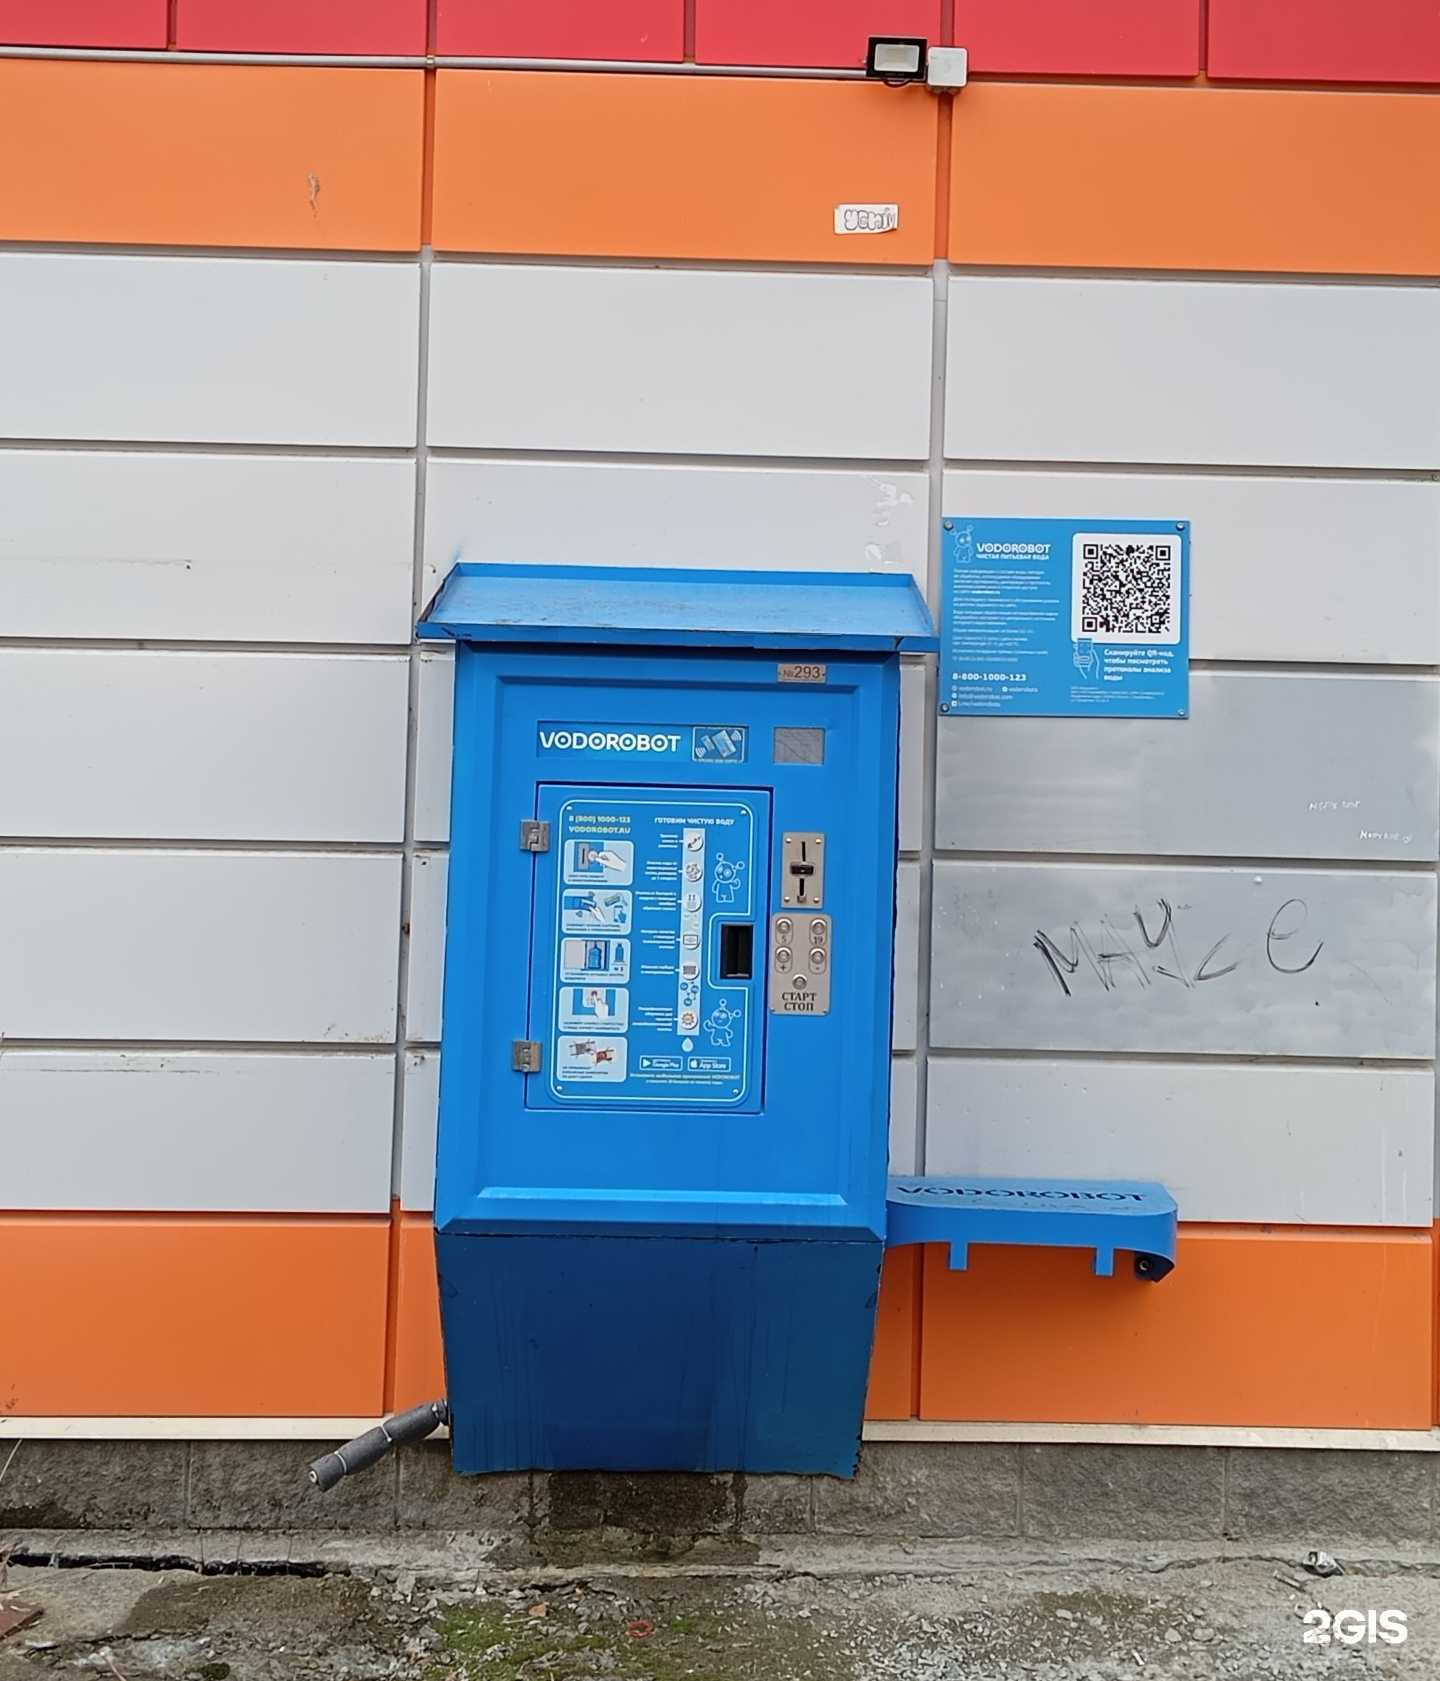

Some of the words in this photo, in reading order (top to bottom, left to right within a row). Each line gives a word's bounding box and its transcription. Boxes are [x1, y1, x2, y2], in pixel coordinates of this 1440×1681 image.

[976, 543, 1051, 554] VODOROBOT
[1104, 649, 1146, 657] Сканируйте
[1127, 658, 1169, 666] посмотреть
[1104, 666, 1142, 674] протоколы
[952, 672, 1027, 681] 8-800-1000-123
[539, 731, 681, 752] VODOROBOT
[715, 818, 735, 826] ВОДУ
[782, 992, 817, 1002] СТАРТ
[784, 1002, 814, 1011] СТОП
[896, 1186, 1146, 1200] VODOROBOT
